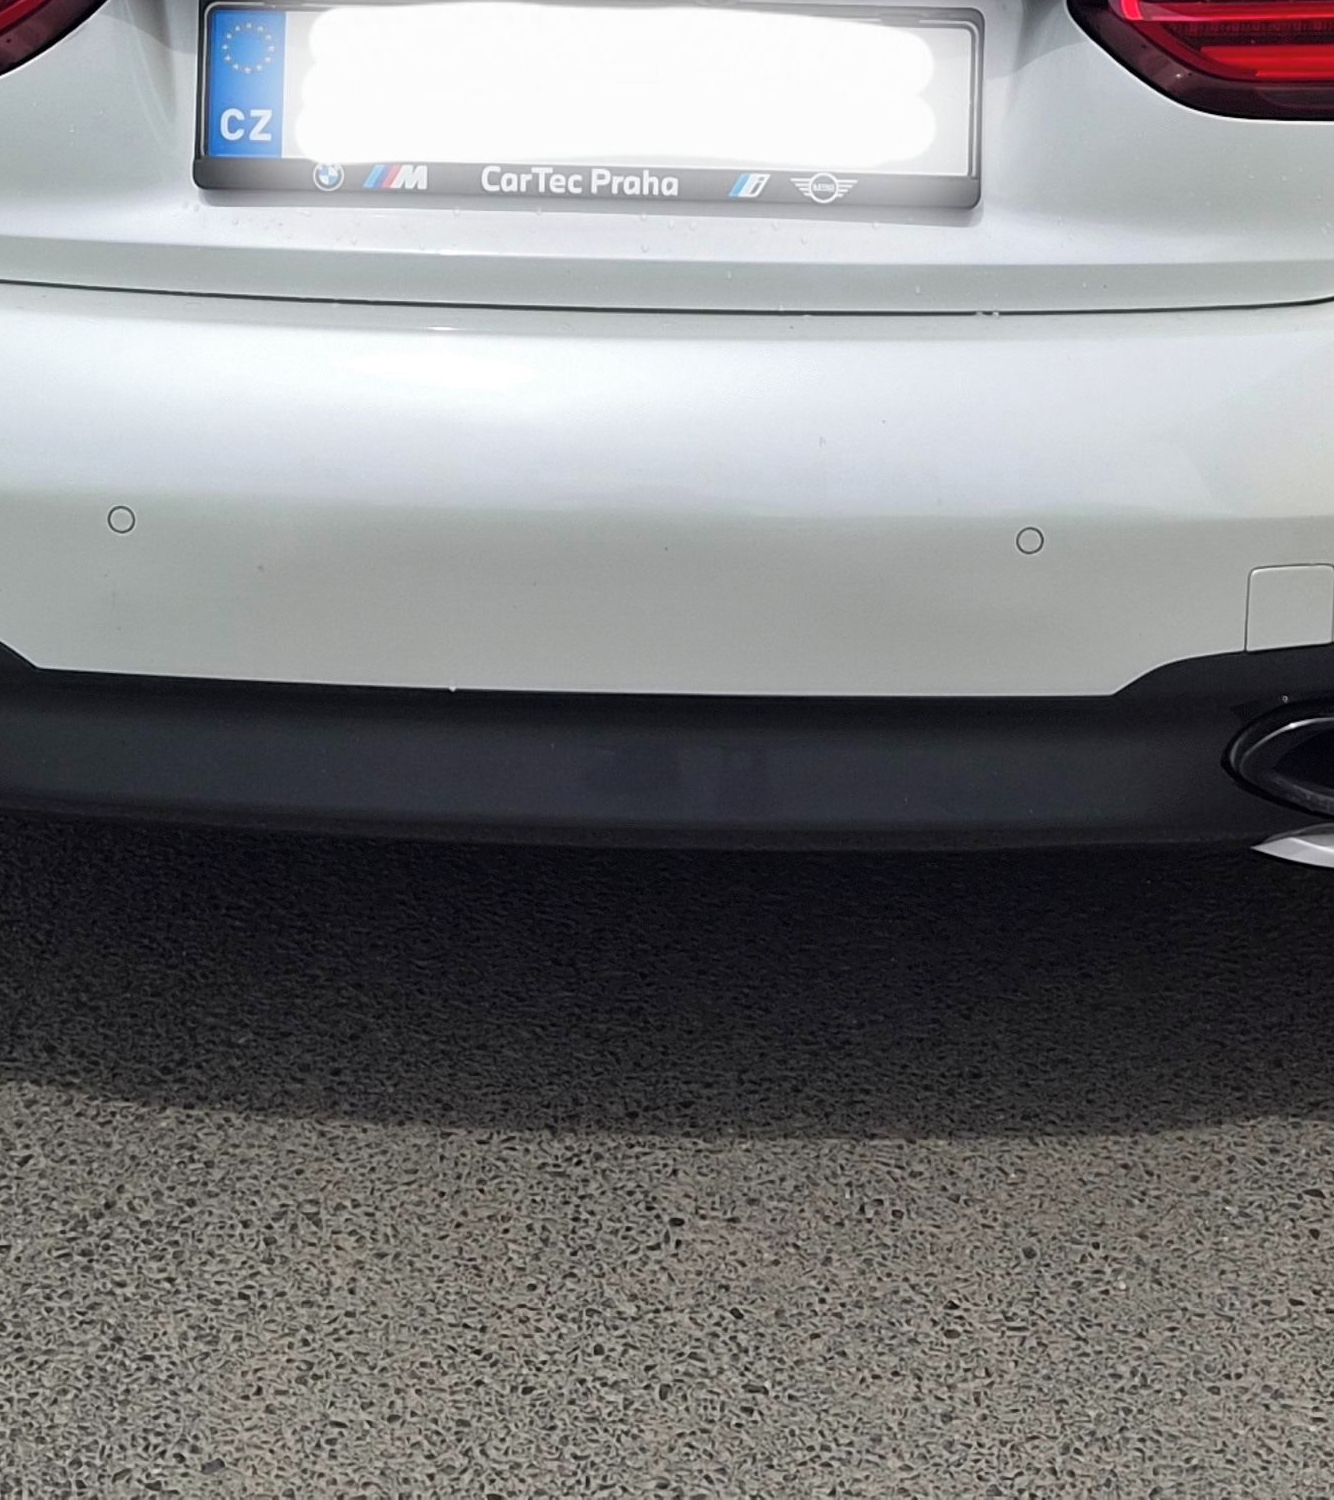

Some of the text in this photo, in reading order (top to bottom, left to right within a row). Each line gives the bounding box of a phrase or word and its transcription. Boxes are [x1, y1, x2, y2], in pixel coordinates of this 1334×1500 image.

[220, 108, 272, 141] CZ
[388, 164, 428, 190] M
[481, 165, 679, 197] CarTec Praha
